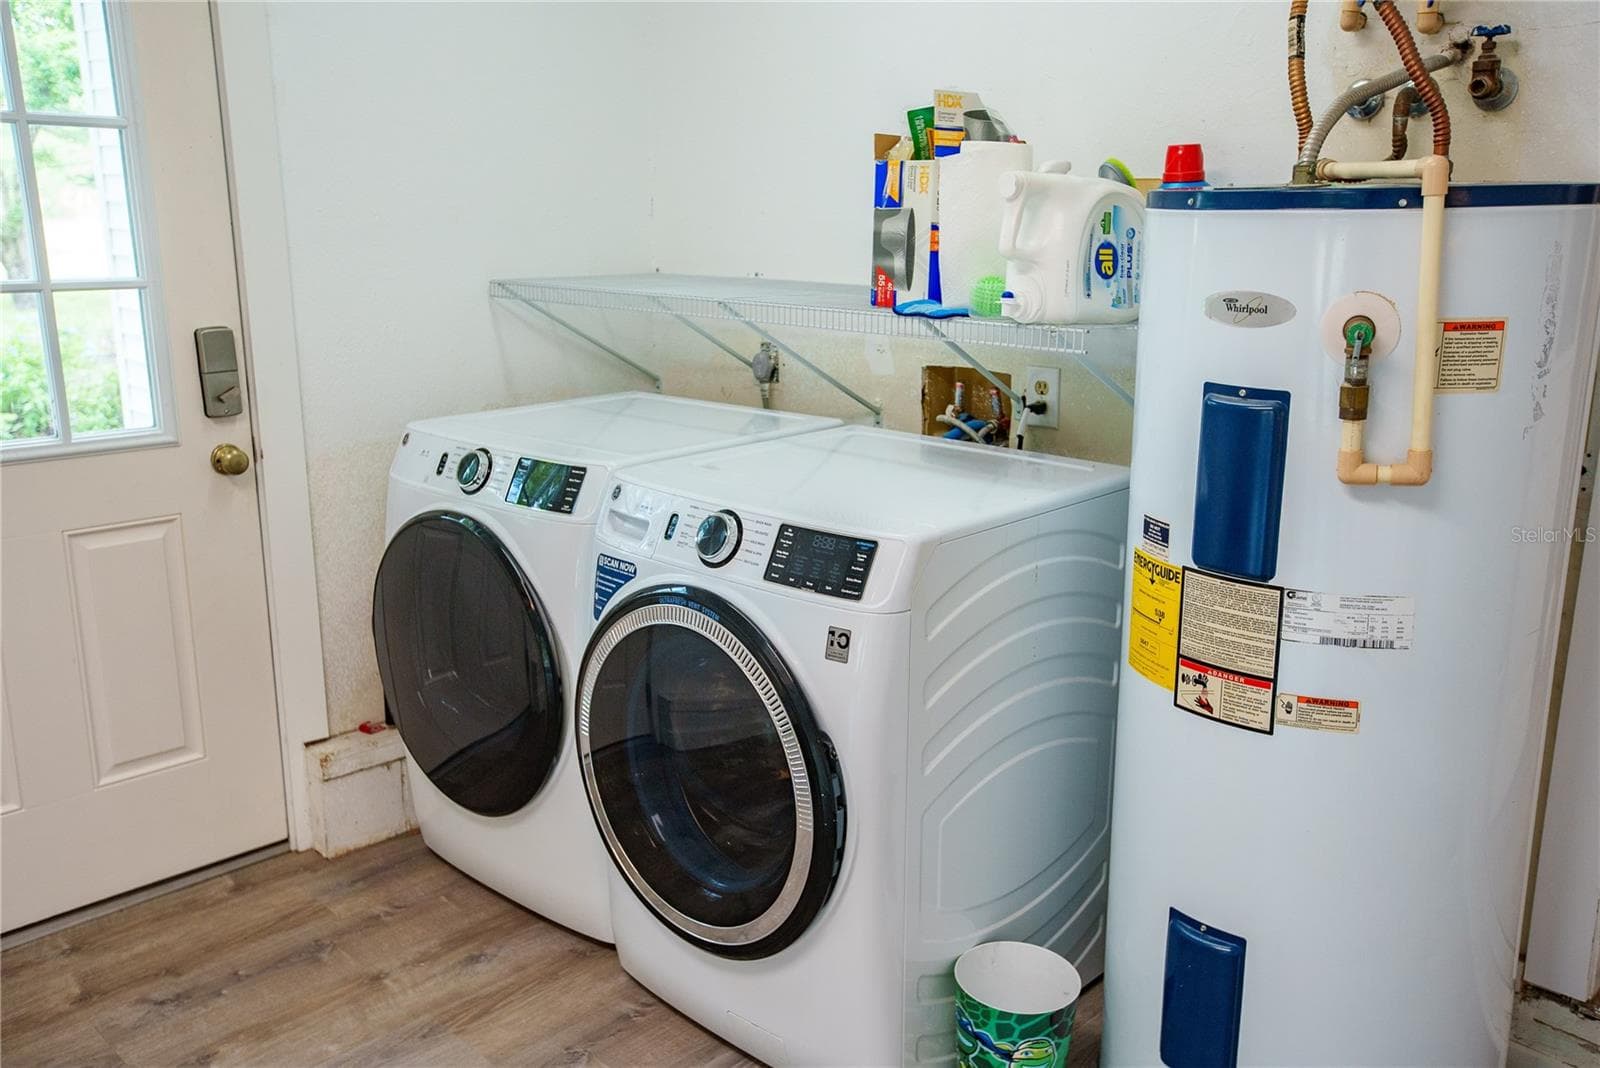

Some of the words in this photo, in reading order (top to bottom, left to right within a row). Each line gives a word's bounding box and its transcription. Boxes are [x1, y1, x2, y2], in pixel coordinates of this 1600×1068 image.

[937, 93, 964, 109] HDX
[918, 165, 930, 195] HDX
[1098, 247, 1114, 276] all
[1225, 303, 1268, 316] Whirlpool
[828, 630, 850, 650] 10
[1212, 670, 1246, 684] DANGER
[1312, 698, 1350, 707] WARNING
